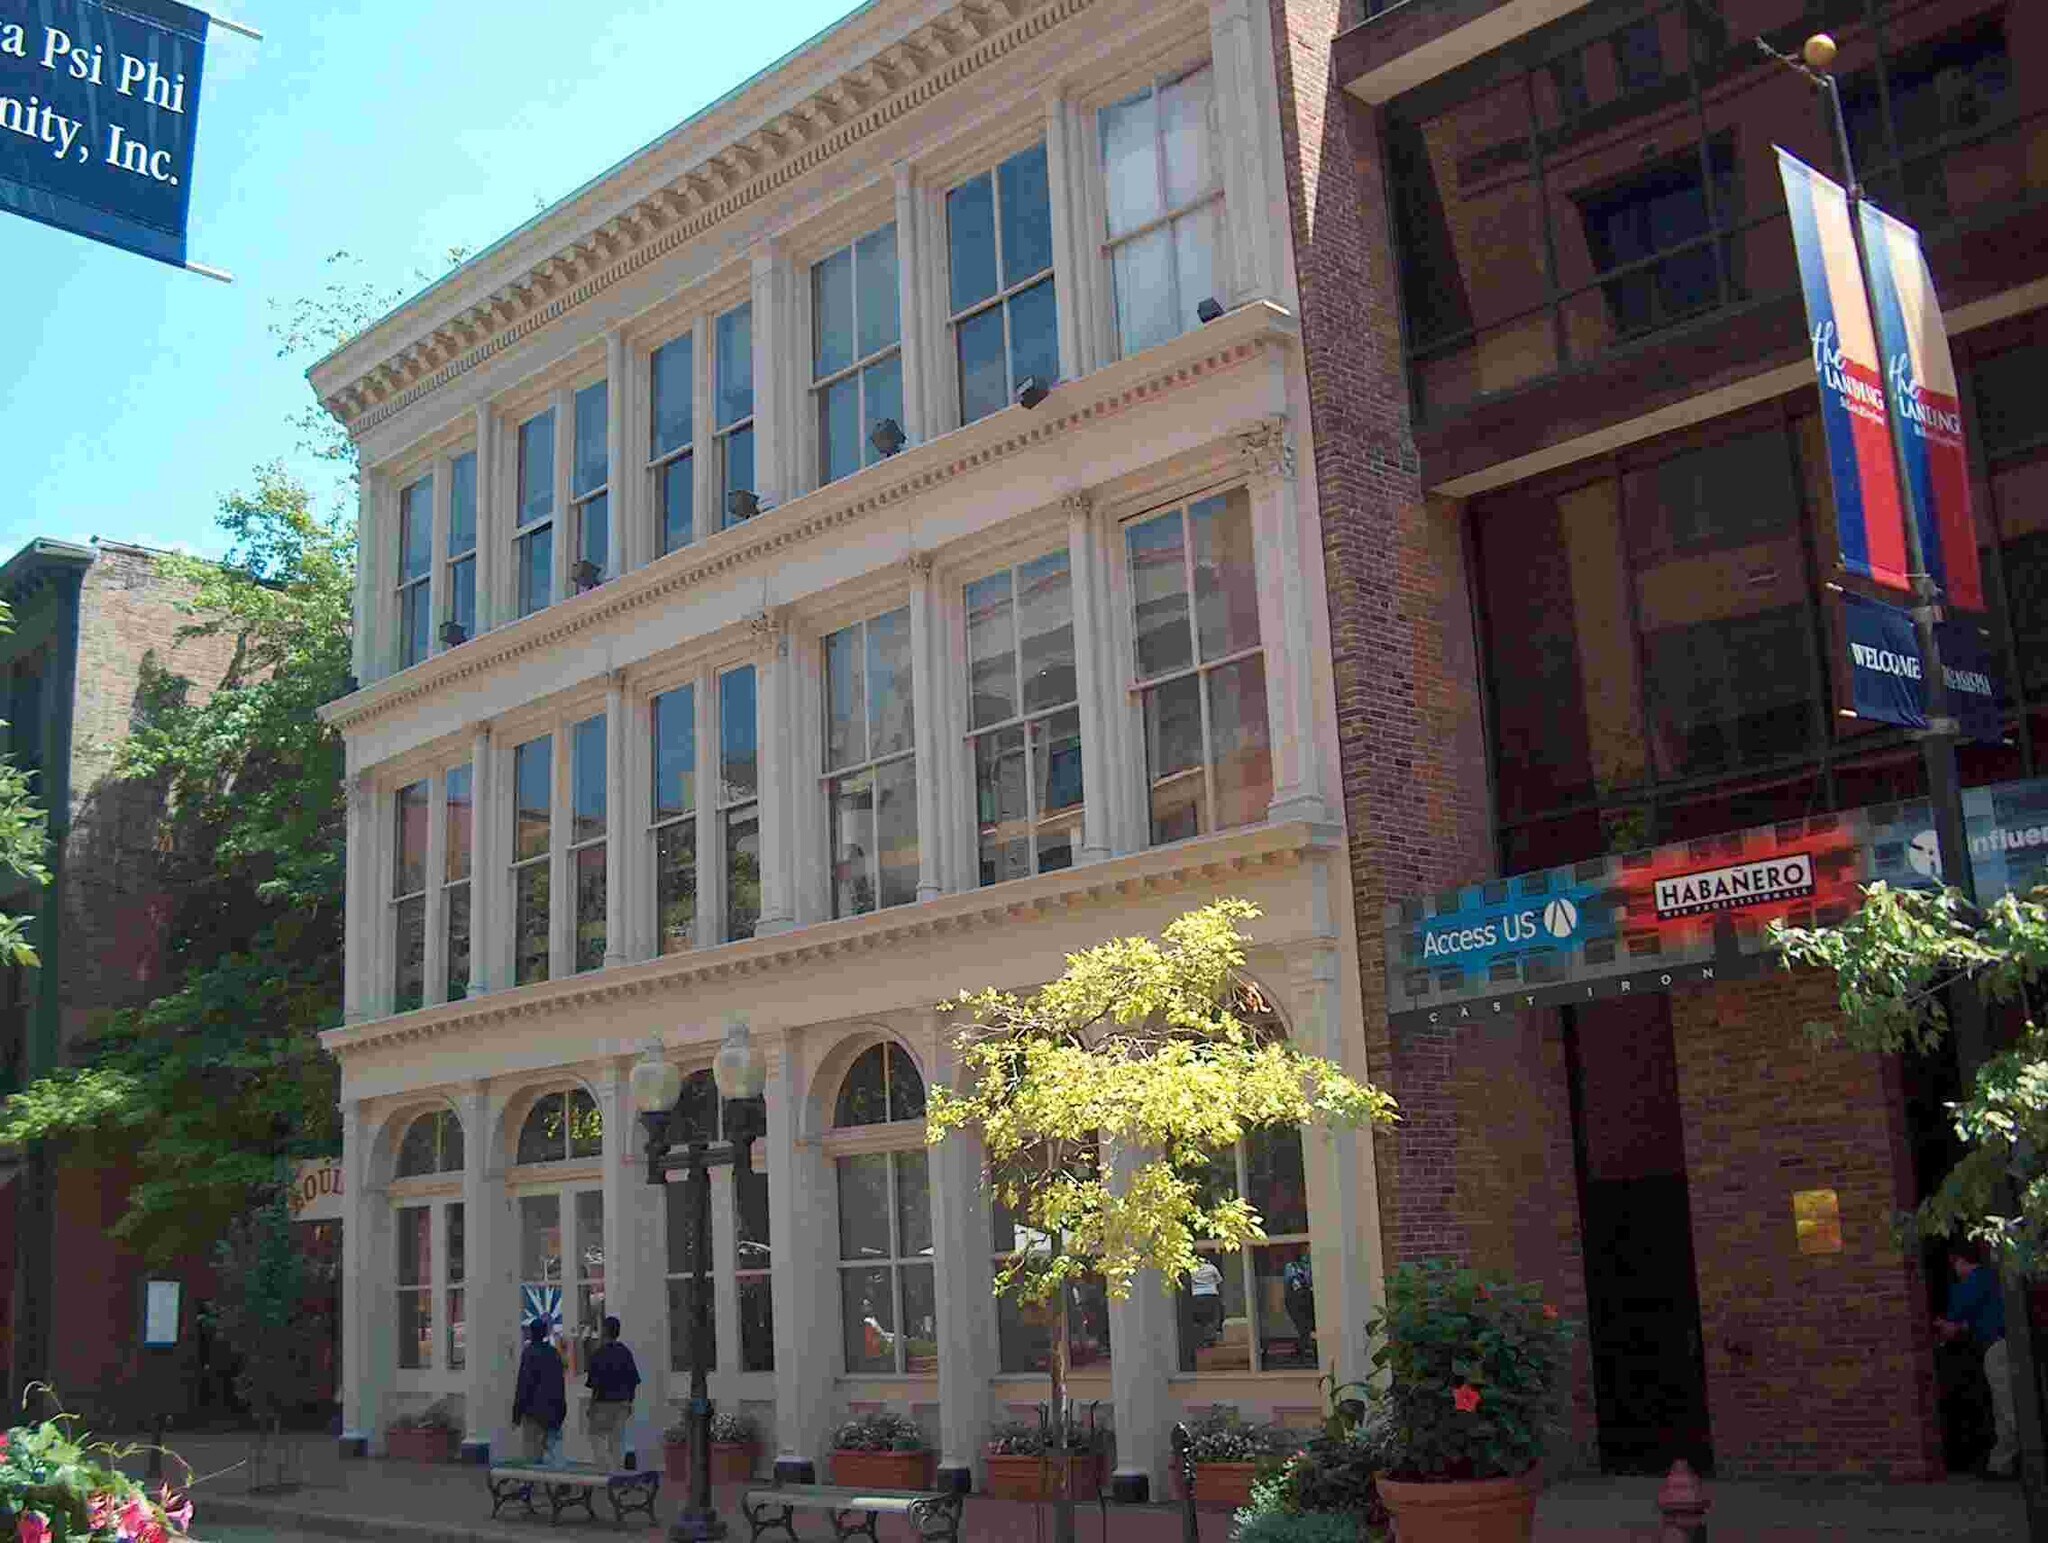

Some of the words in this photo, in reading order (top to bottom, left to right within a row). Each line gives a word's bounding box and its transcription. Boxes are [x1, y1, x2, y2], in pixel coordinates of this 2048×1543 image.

[0, 21, 27, 57] a
[40, 26, 103, 85] Psi
[116, 53, 186, 114] Phi
[105, 123, 179, 186] Inc.
[1811, 319, 1847, 372] the
[1824, 365, 1885, 411] LANDING
[1888, 352, 1919, 399] the
[1899, 395, 1962, 435] LANDING
[1850, 642, 1923, 680] WELCOME
[1423, 924, 1498, 959] Access
[1502, 910, 1537, 943] US
[1428, 995, 1536, 1023] CAST
[1586, 966, 1716, 998] IRON
